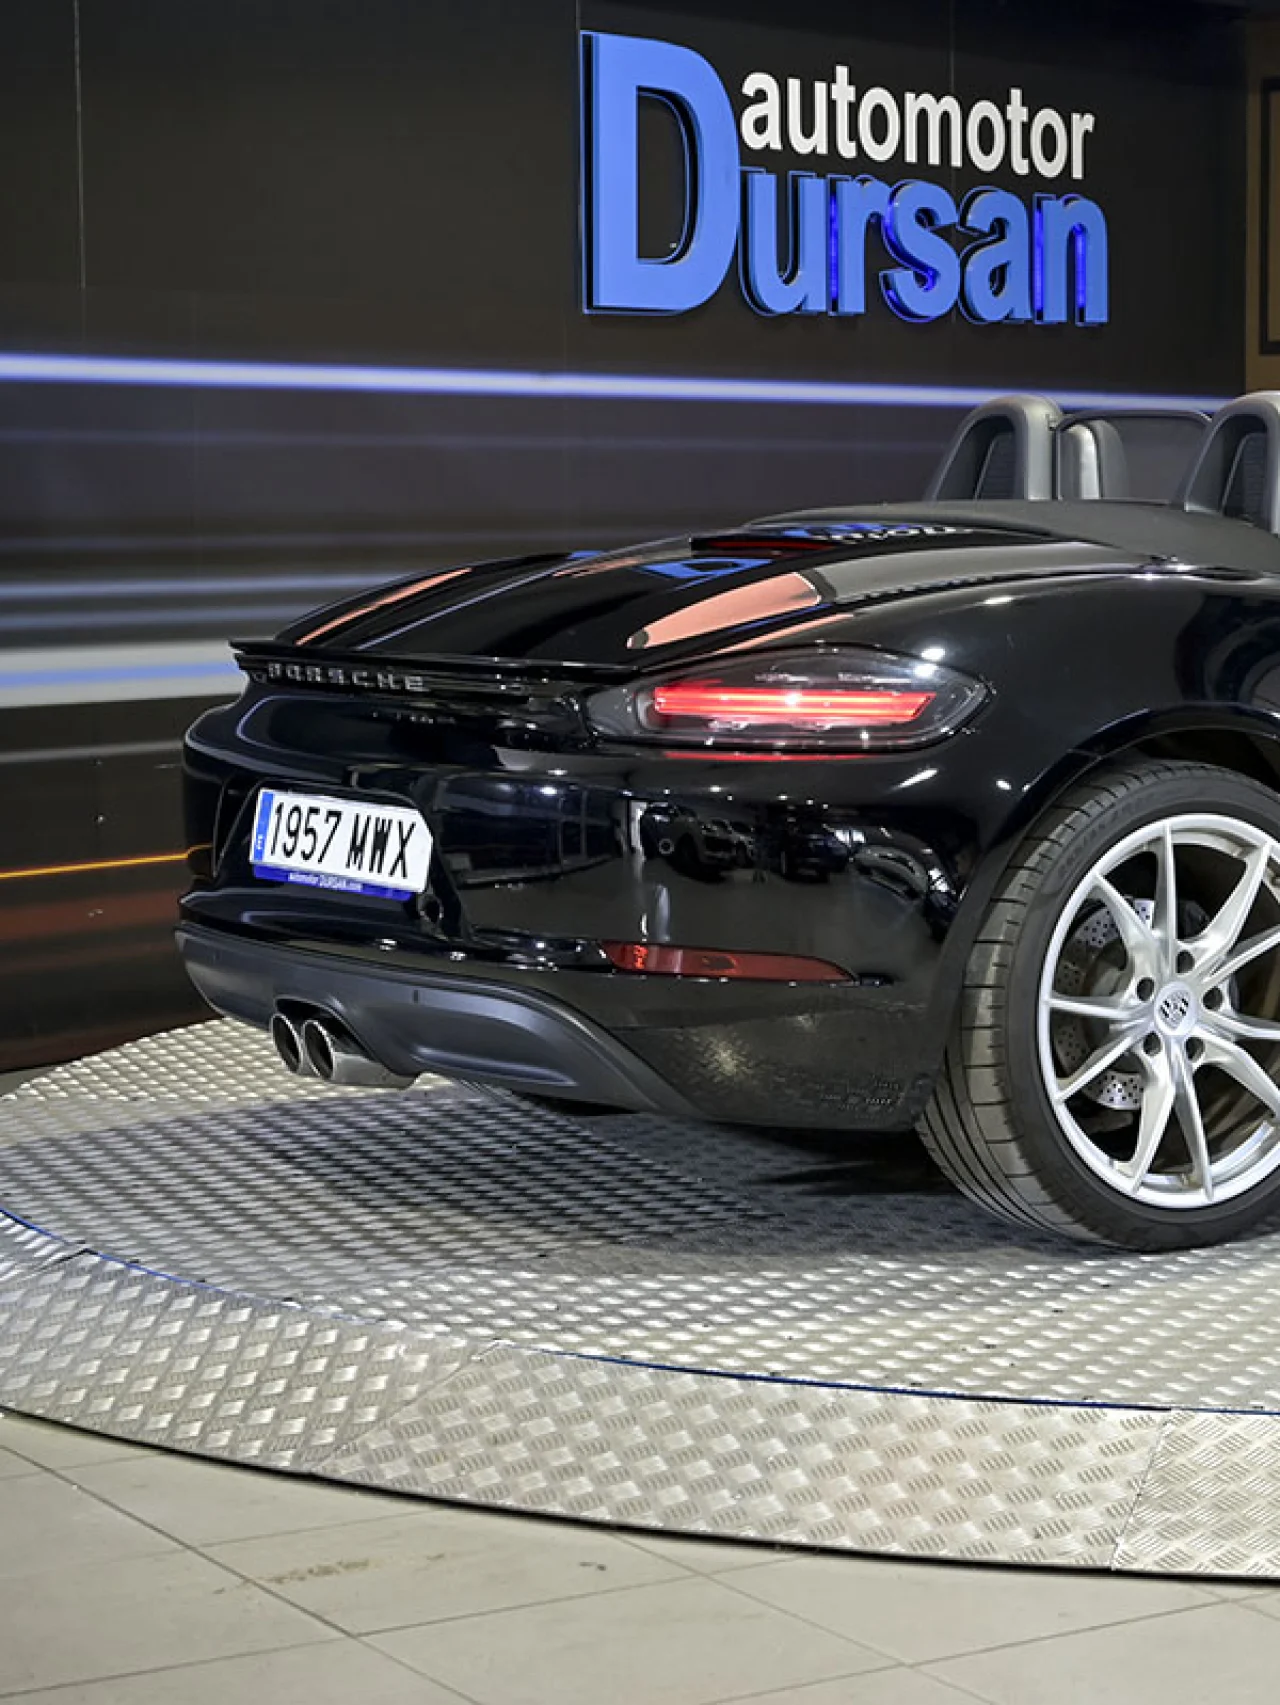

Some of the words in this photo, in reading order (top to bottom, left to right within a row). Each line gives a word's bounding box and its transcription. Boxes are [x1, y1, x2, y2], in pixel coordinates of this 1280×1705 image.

[741, 65, 1094, 180] automotor
[580, 30, 1109, 326] Dursan
[268, 662, 430, 692] PORSCHE
[270, 801, 343, 864] 1957
[345, 812, 417, 880] MWX
